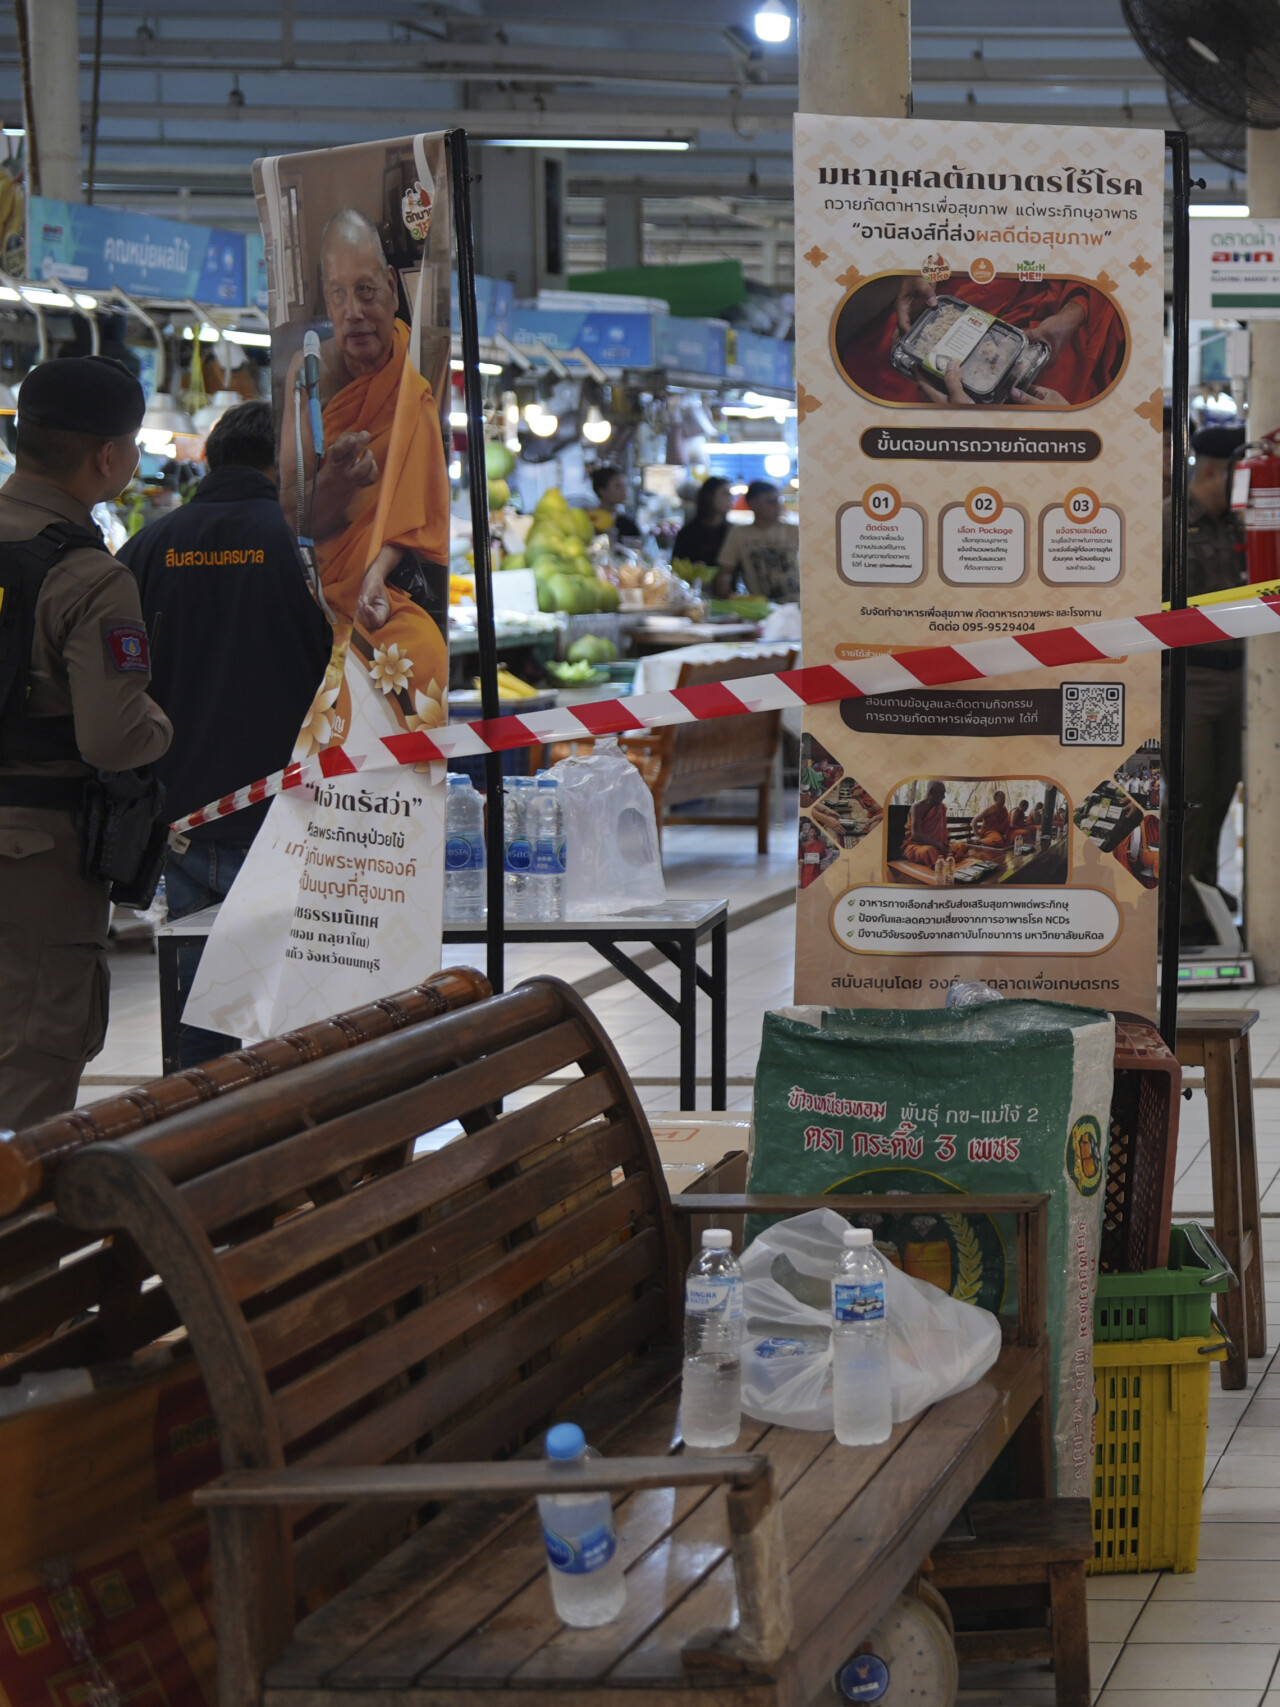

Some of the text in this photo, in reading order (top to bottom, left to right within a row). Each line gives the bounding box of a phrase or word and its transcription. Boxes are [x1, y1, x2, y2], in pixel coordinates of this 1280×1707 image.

[818, 164, 1144, 196] มหากุศลตักบาตรไร้โรค
[824, 197, 1138, 222] ถวายภัตตาหารเพื่อสุขภาพ แด่พระภิกษุอาพาธ
[1017, 262, 1046, 272] HEALTH
[1019, 271, 1043, 281] ME!!
[877, 431, 1086, 454] ขั้นตอนการถวายภัตตาหาร
[872, 497, 890, 509] 01
[975, 498, 993, 511] 02
[1073, 500, 1090, 512] 03
[865, 523, 899, 532] ติดต่อเรา
[957, 526, 1014, 535] เลือก Package
[1056, 526, 1107, 534] แจ้งรายละเอียด
[166, 548, 265, 567] สืบสวนนครบาล
[860, 606, 1102, 619] รับจัดทำอาหารเพื่อสุขภาพ ภัตตาหารถวายพระ และโรงทาน
[929, 621, 1036, 632] ติดต่อ 095-9529404
[865, 711, 1039, 727] การถวายภัตตาหารเพื่อสุขภาพ ได้ที่
[1045, 917, 1070, 925] NCDs
[1024, 929, 1105, 941] มหาวิทยาลัยมหิดล
[306, 949, 381, 973] จังหวัดนนทบุรี
[831, 974, 922, 991] สนับสนุนโดย
[788, 1085, 1039, 1128] ข้าวเหนียวหอม พันธุ์ กข-แม่โจ้ 2
[803, 1121, 1021, 1163] ตรา กระติ๊บ 3 เพชร
